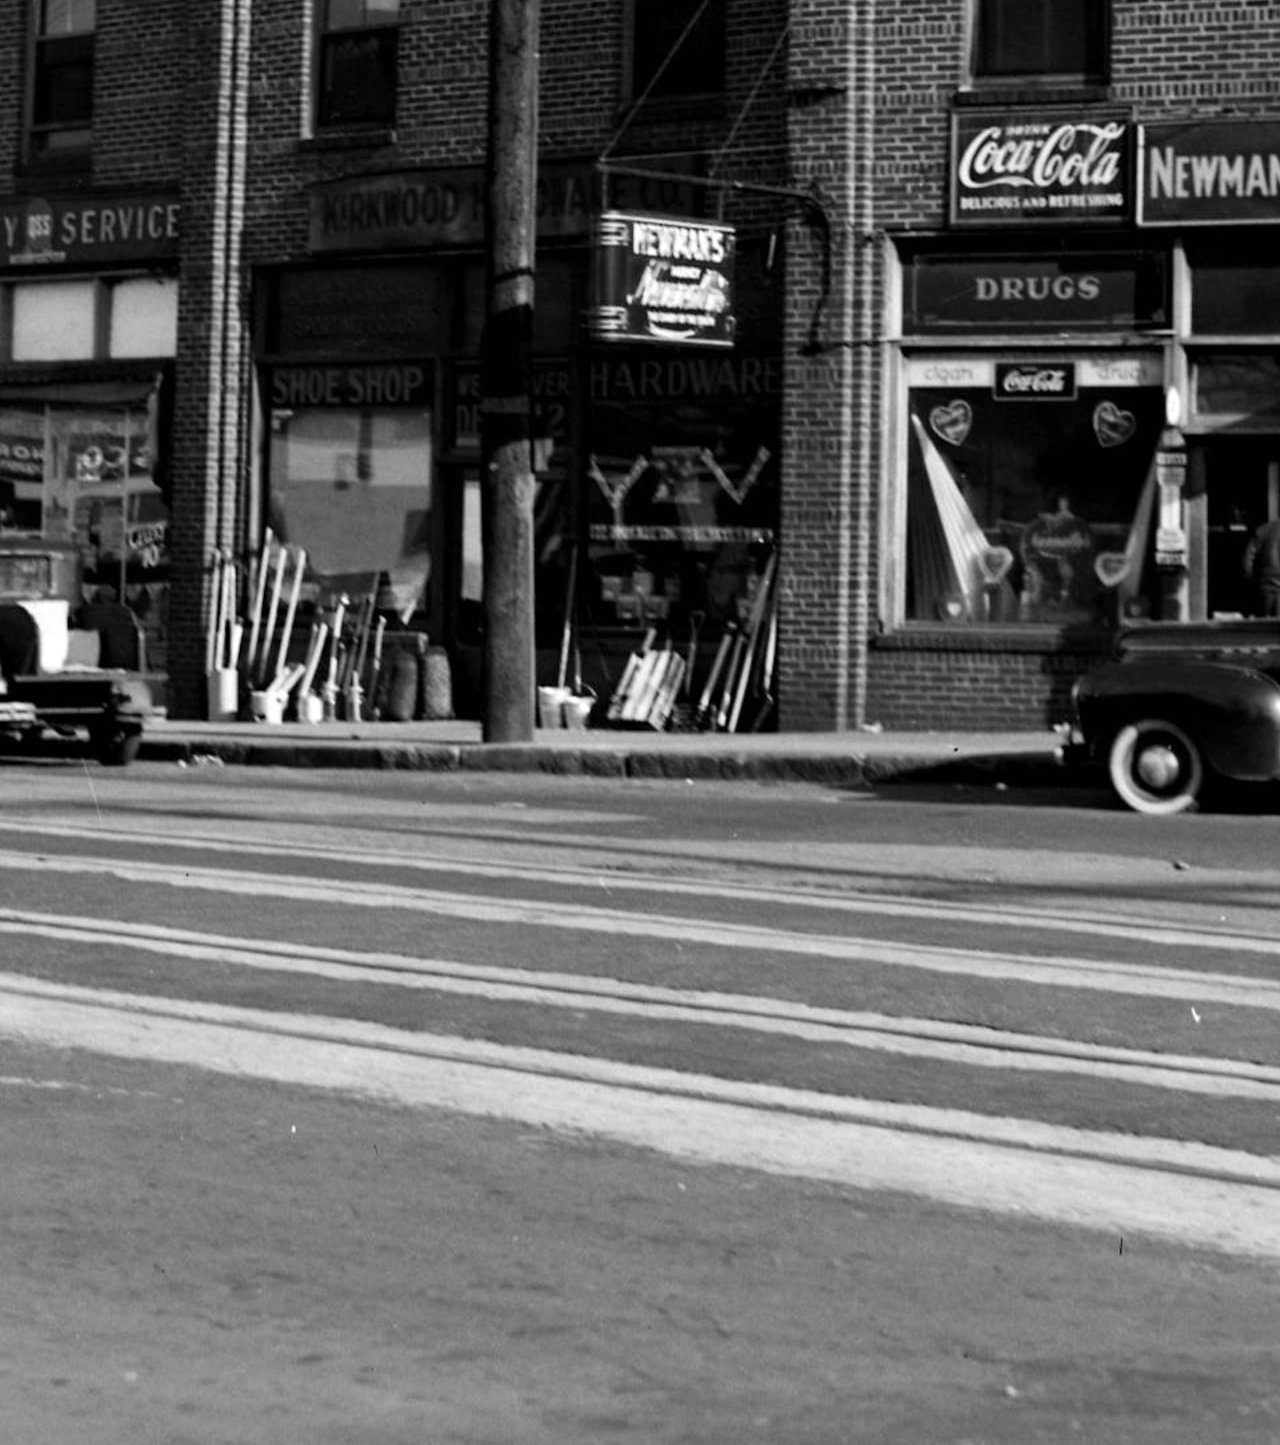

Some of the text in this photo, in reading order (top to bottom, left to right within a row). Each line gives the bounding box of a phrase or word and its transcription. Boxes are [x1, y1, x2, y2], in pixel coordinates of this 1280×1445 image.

[1005, 125, 1051, 136] DRINK
[959, 123, 1125, 188] Coca-Cola
[323, 186, 458, 232] KIRKWOOD
[960, 194, 1124, 210] DELICIOUS AND REFRESHING
[61, 204, 181, 244] SERVICE
[975, 275, 1101, 301] DRUGS
[272, 365, 425, 404] SHOE SHOP
[589, 357, 783, 398] HARDWARE
